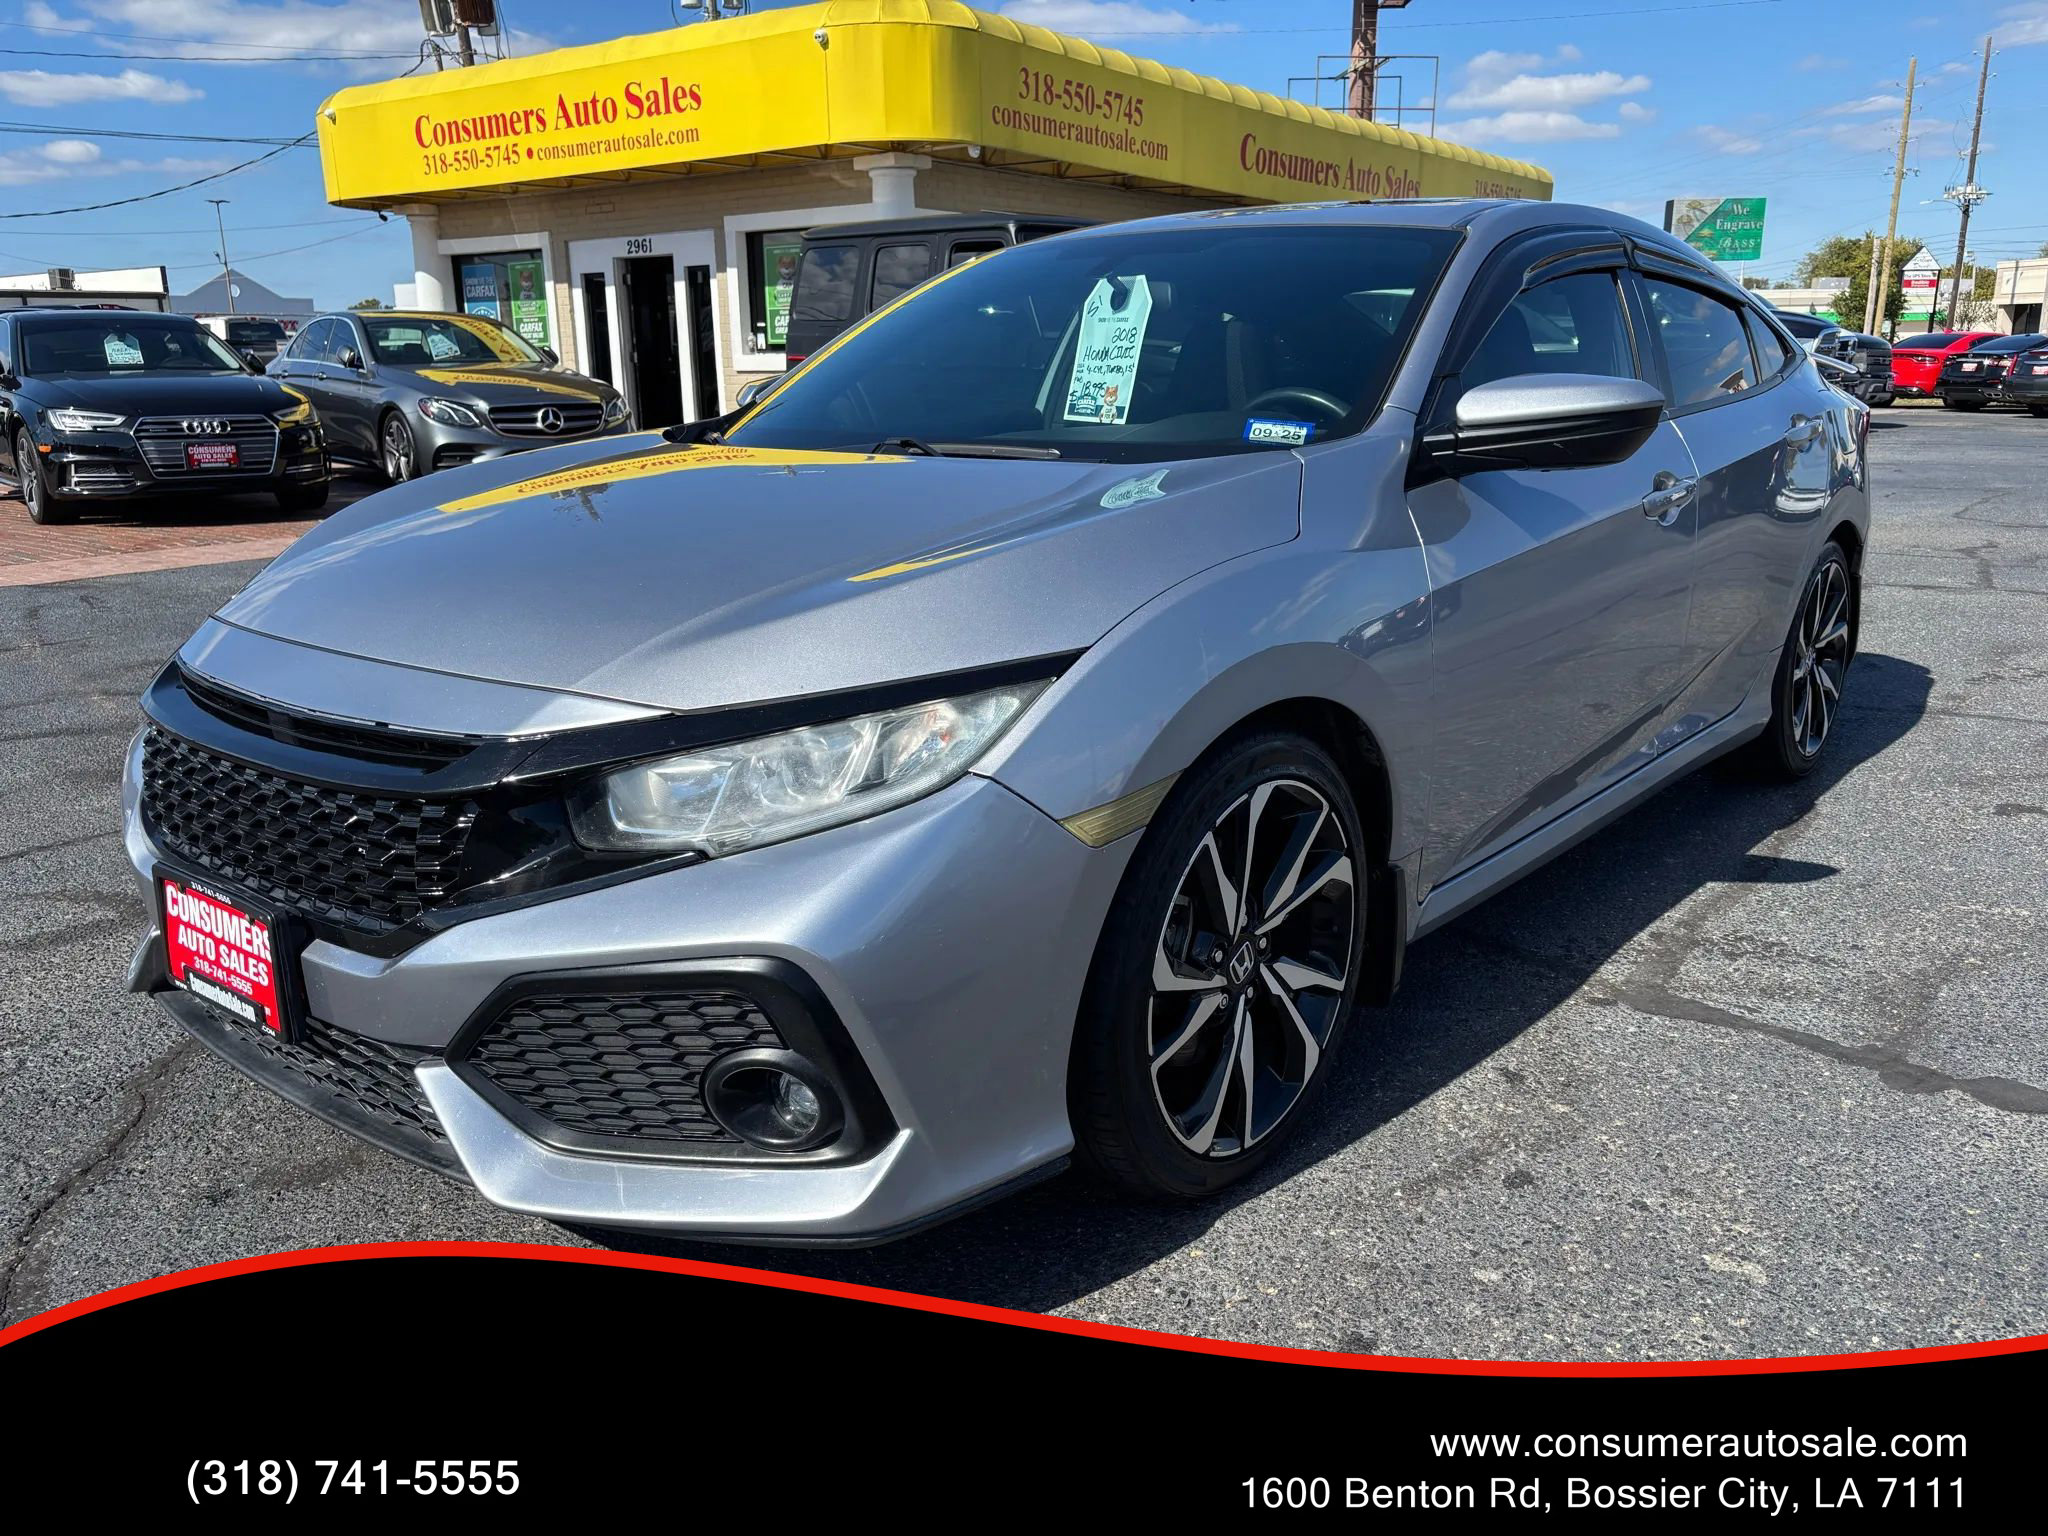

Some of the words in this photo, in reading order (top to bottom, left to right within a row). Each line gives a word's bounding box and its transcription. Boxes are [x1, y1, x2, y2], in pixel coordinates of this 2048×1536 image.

[1018, 66, 1144, 127] 318-550-5745
[415, 107, 547, 149] Consumers
[553, 93, 618, 131] Auto
[624, 77, 702, 120] Sales
[991, 104, 1169, 161] consumerautosale.com
[423, 143, 521, 176] 318-550-5745
[537, 127, 700, 161] consumerautosale.com
[1240, 133, 1340, 188] Consumers
[1344, 157, 1381, 196] Auto
[1384, 165, 1421, 198] Sales
[1733, 204, 1750, 216] We
[1716, 219, 1764, 232] Engrave
[627, 238, 653, 254] 2961
[466, 286, 496, 297] CARFAX
[520, 322, 543, 332] CARFAX
[1112, 326, 1138, 344] 2018
[1252, 428, 1273, 438] 09
[1280, 429, 1302, 441] 25
[188, 446, 236, 454] CONSUMERS
[165, 883, 272, 963] CONSUMERS
[177, 925, 216, 962] AUTO
[219, 943, 269, 987] SALES
[193, 956, 253, 995] 318-741-5555
